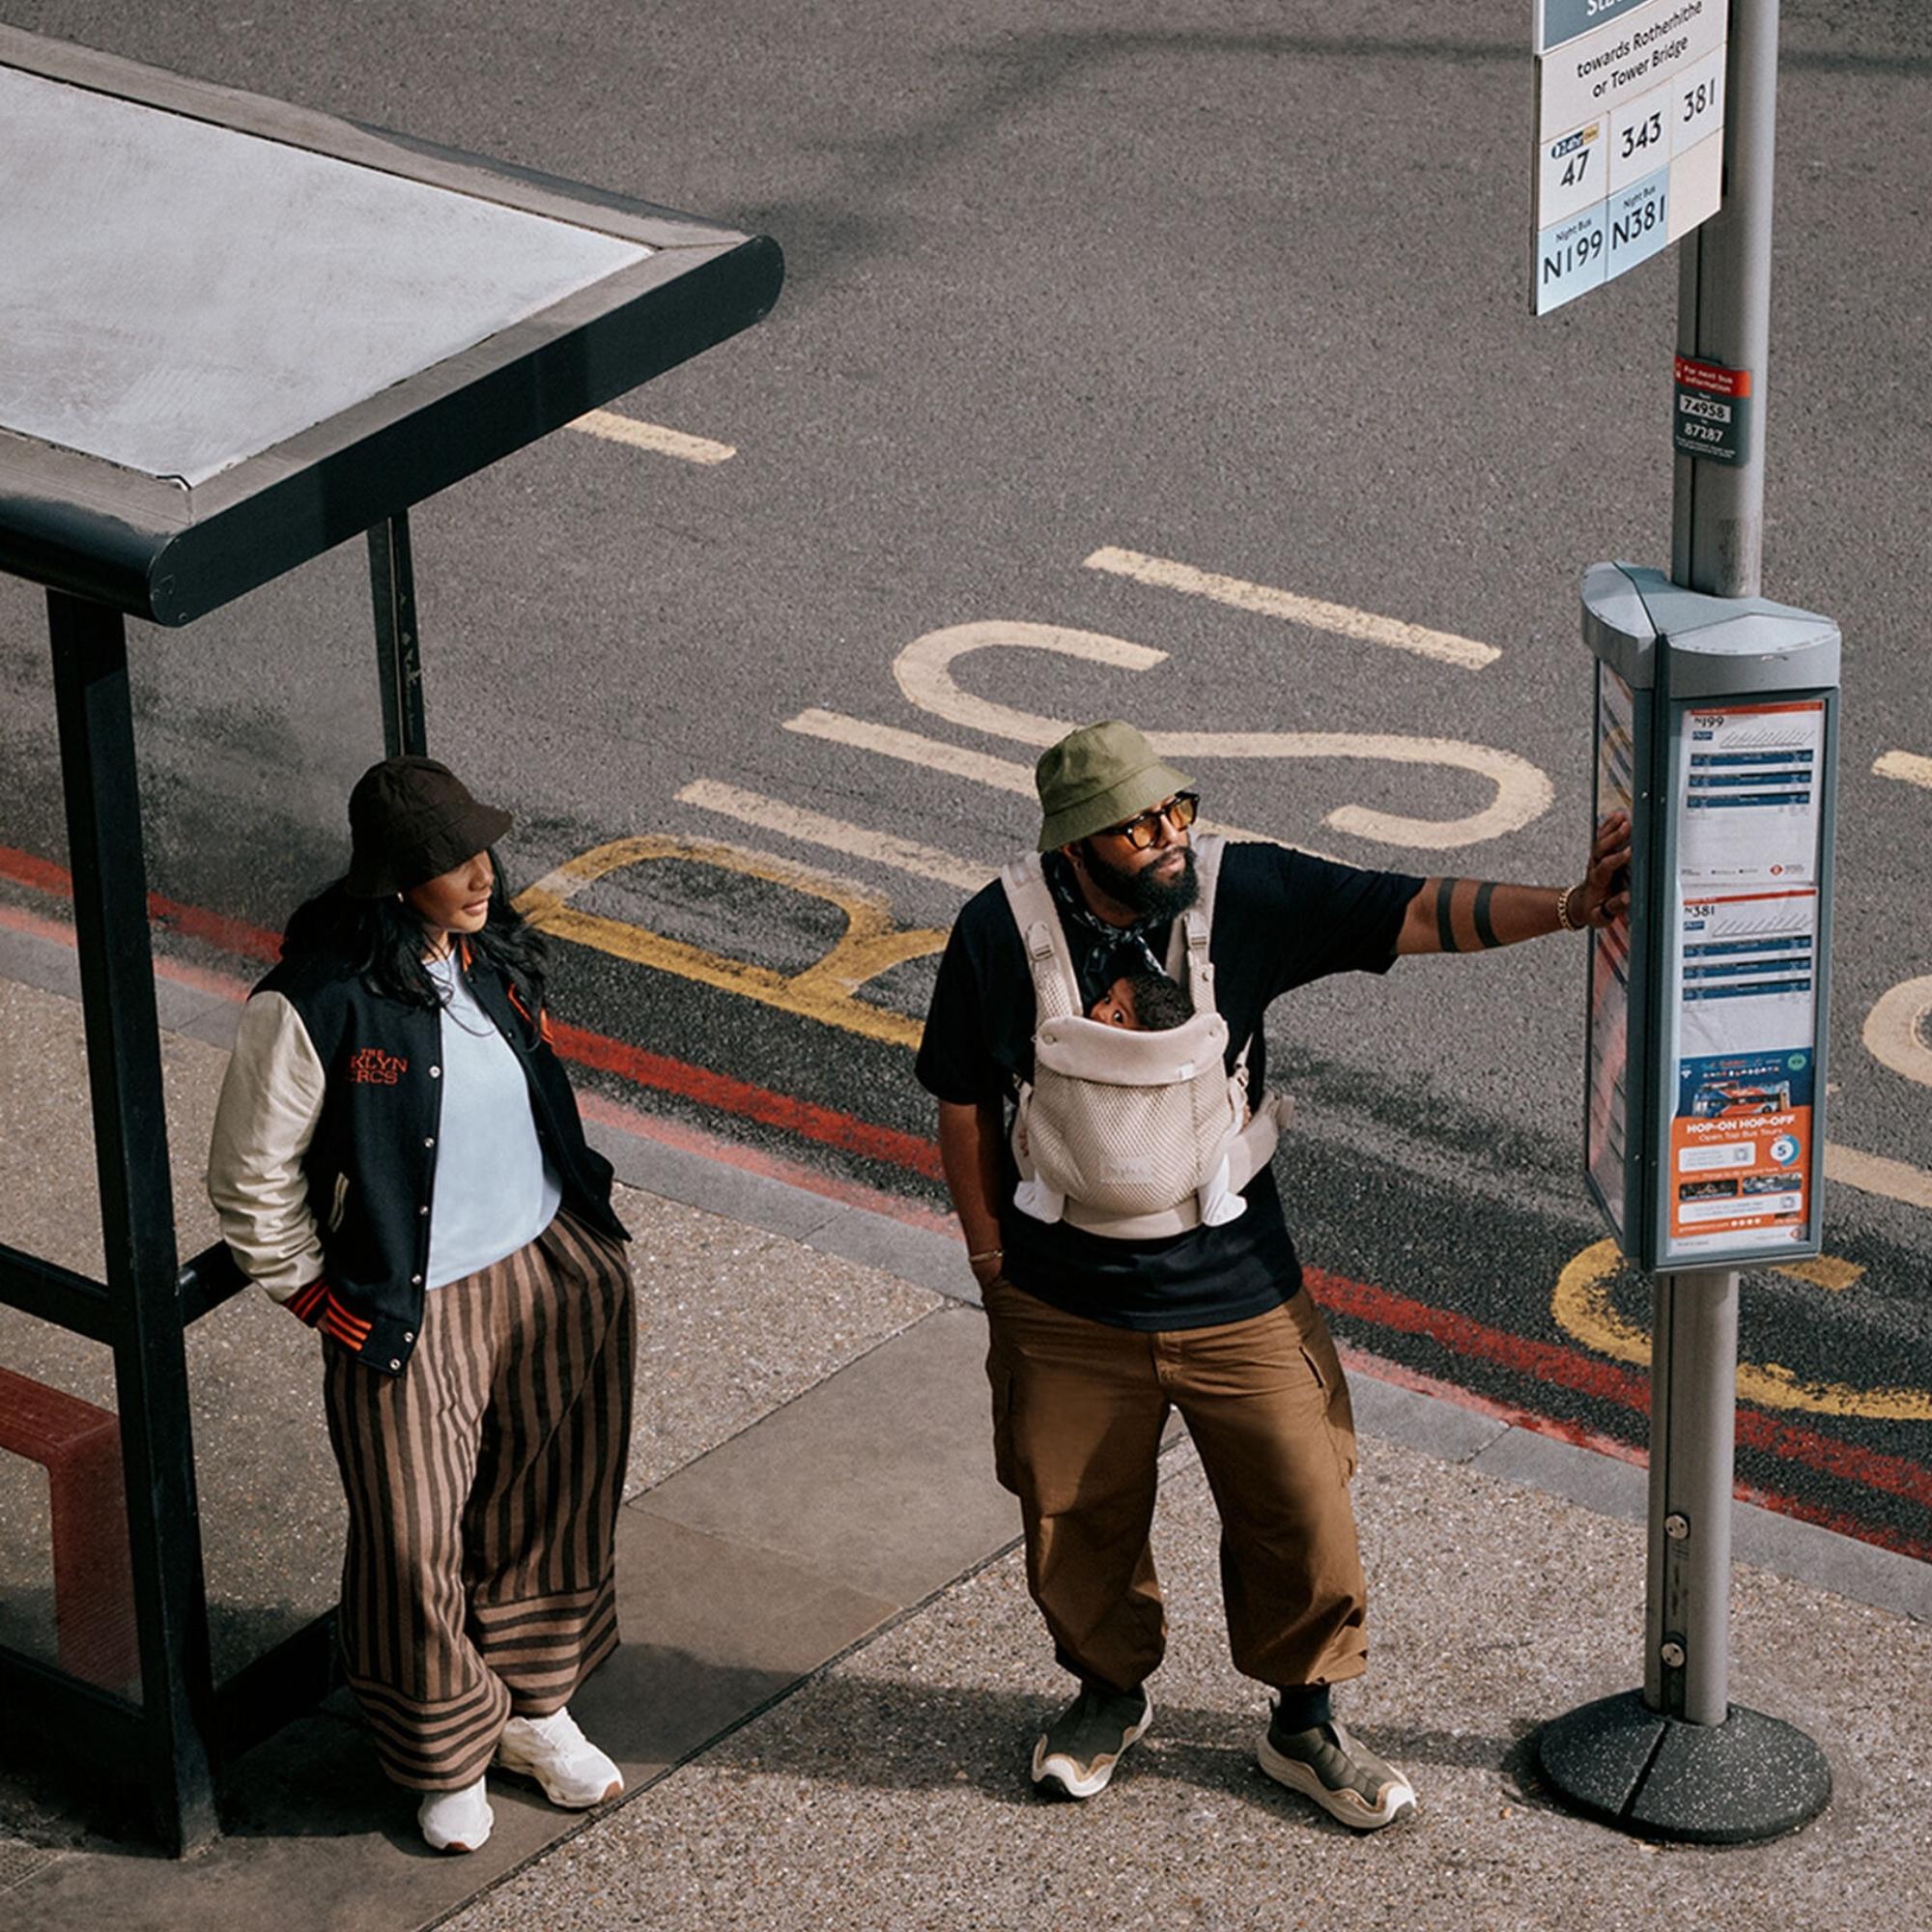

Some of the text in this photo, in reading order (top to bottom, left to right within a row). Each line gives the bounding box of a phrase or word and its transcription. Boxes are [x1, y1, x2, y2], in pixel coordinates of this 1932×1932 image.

[1577, 1, 1703, 78] towards Rotherhithe
[1592, 37, 1689, 98] or Tower Bridge
[1683, 78, 1715, 123] 381
[1621, 112, 1662, 158] 343
[1560, 150, 1590, 186] 47
[1623, 185, 1657, 210] Night Bus
[1555, 217, 1592, 243] Night Bus
[1612, 196, 1665, 250] N381
[1544, 230, 1604, 285] N199
[1694, 716, 1724, 727] N199
[1685, 905, 1715, 918] N381
[351, 1055, 408, 1072] KLYN
[1686, 1115, 1796, 1134] HOP-ON HOP-OFF
[1777, 1144, 1787, 1157] 5
